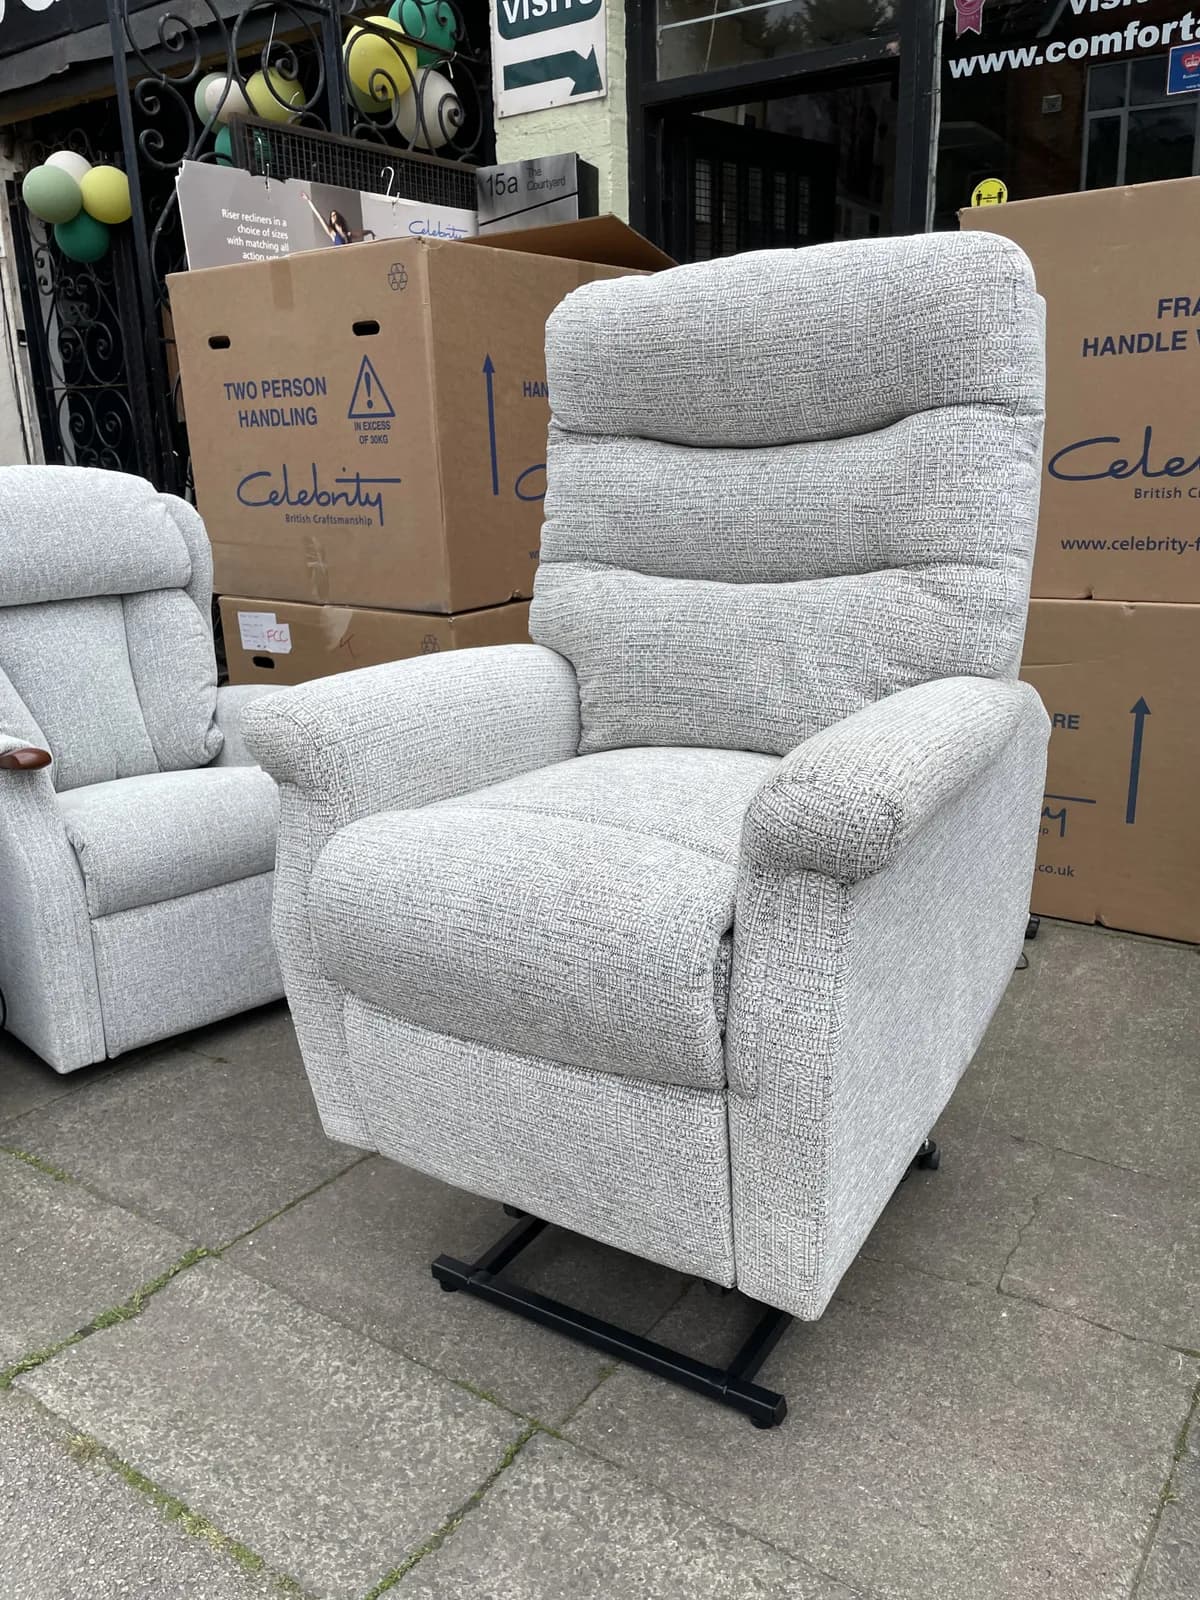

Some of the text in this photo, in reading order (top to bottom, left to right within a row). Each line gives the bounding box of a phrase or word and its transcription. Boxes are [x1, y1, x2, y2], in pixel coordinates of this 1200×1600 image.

[486, 172, 518, 197] 15a
[526, 176, 566, 192] Courtyard
[221, 208, 287, 227] Riser recliners in a
[237, 223, 288, 240] choice of sizes
[227, 235, 288, 253] with matching all
[242, 251, 265, 261] action
[1082, 330, 1188, 357] HANDLE
[224, 376, 327, 401] TWO PERSON
[523, 381, 549, 398] HAN
[239, 406, 319, 428] HANDLING
[354, 420, 391, 431] IN EXCESS
[359, 434, 389, 445] OF 30KG
[1048, 425, 1200, 482] Cele
[237, 462, 402, 527] Celebrity
[1134, 487, 1182, 499] British
[285, 513, 373, 527] British Craftsmanship
[1061, 535, 1200, 555] www.celebrity-f
[1053, 713, 1080, 730] RE
[1034, 864, 1074, 877] .co.uk
